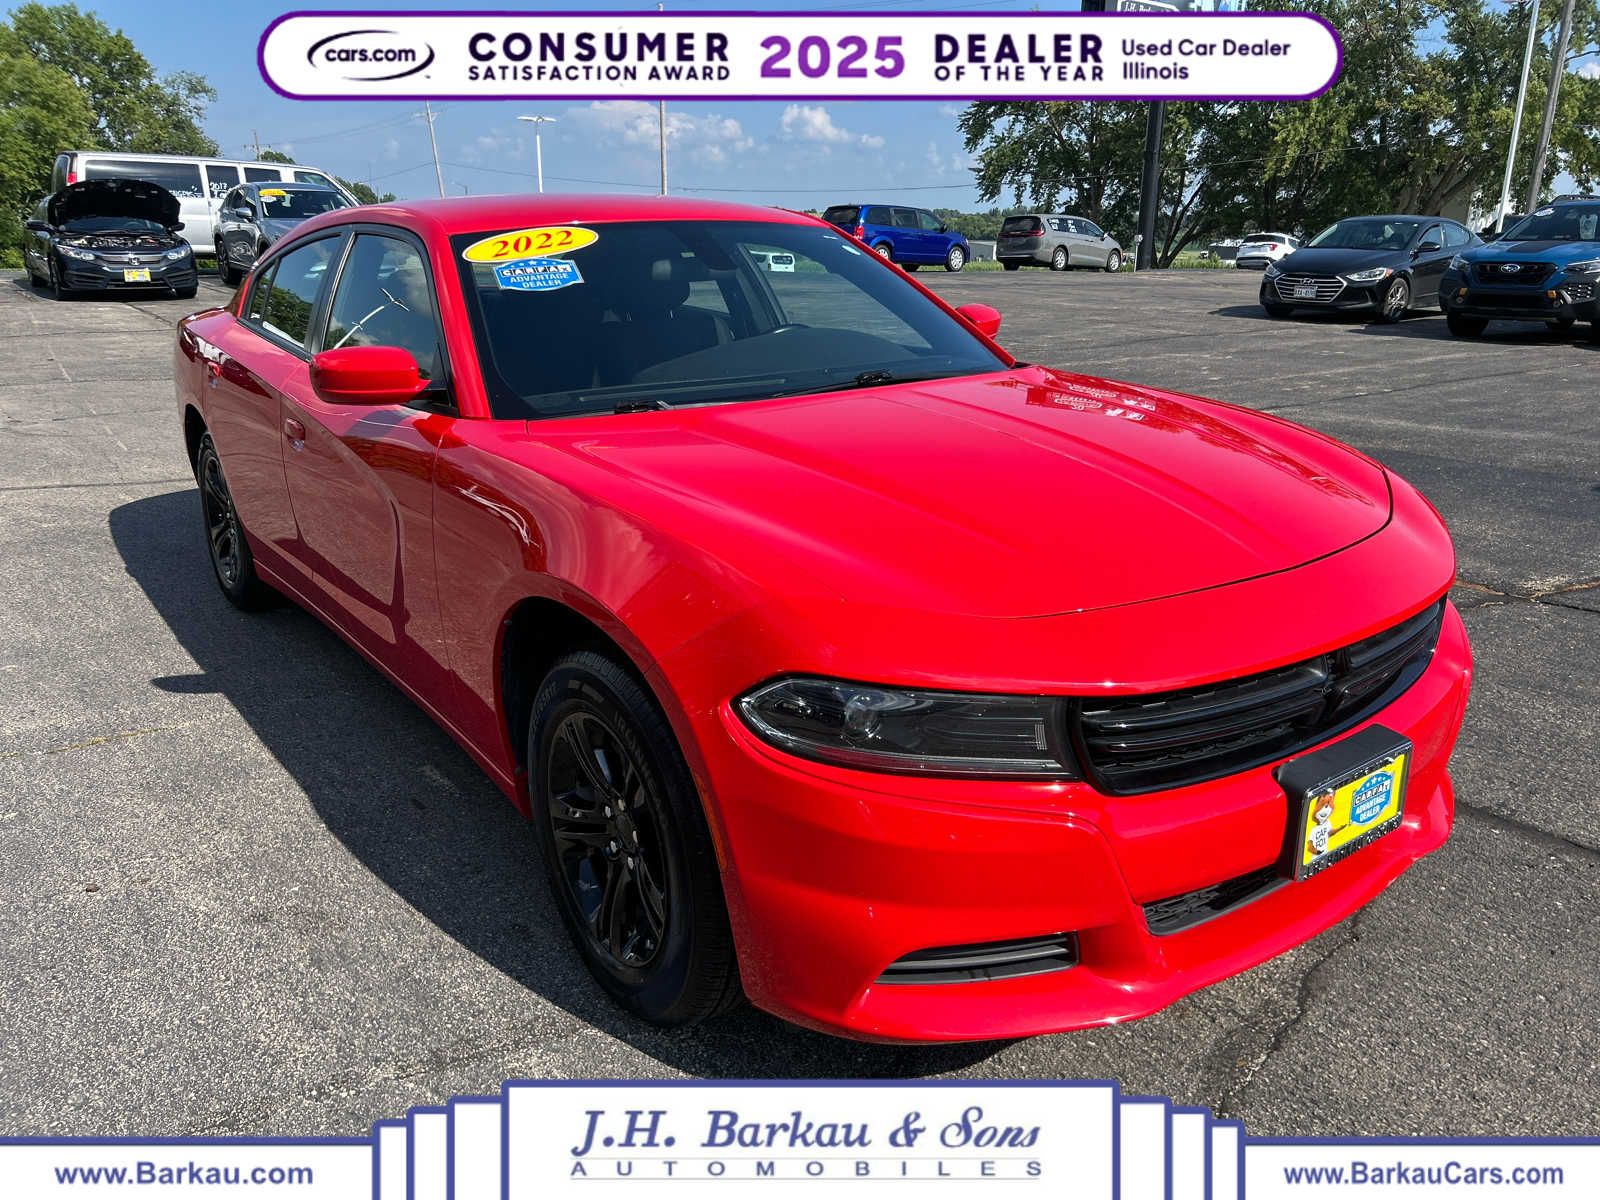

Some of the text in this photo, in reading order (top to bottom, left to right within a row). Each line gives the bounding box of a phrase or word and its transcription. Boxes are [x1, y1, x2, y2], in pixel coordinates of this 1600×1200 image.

[492, 230, 574, 258] 2022
[501, 264, 572, 277] CARFAX
[509, 272, 569, 284] ADVANTAGE
[522, 279, 562, 289] DEALER
[1354, 780, 1391, 806] CARFAX
[1355, 794, 1387, 815] ADVANTAGE
[1359, 805, 1381, 822] DEALER
